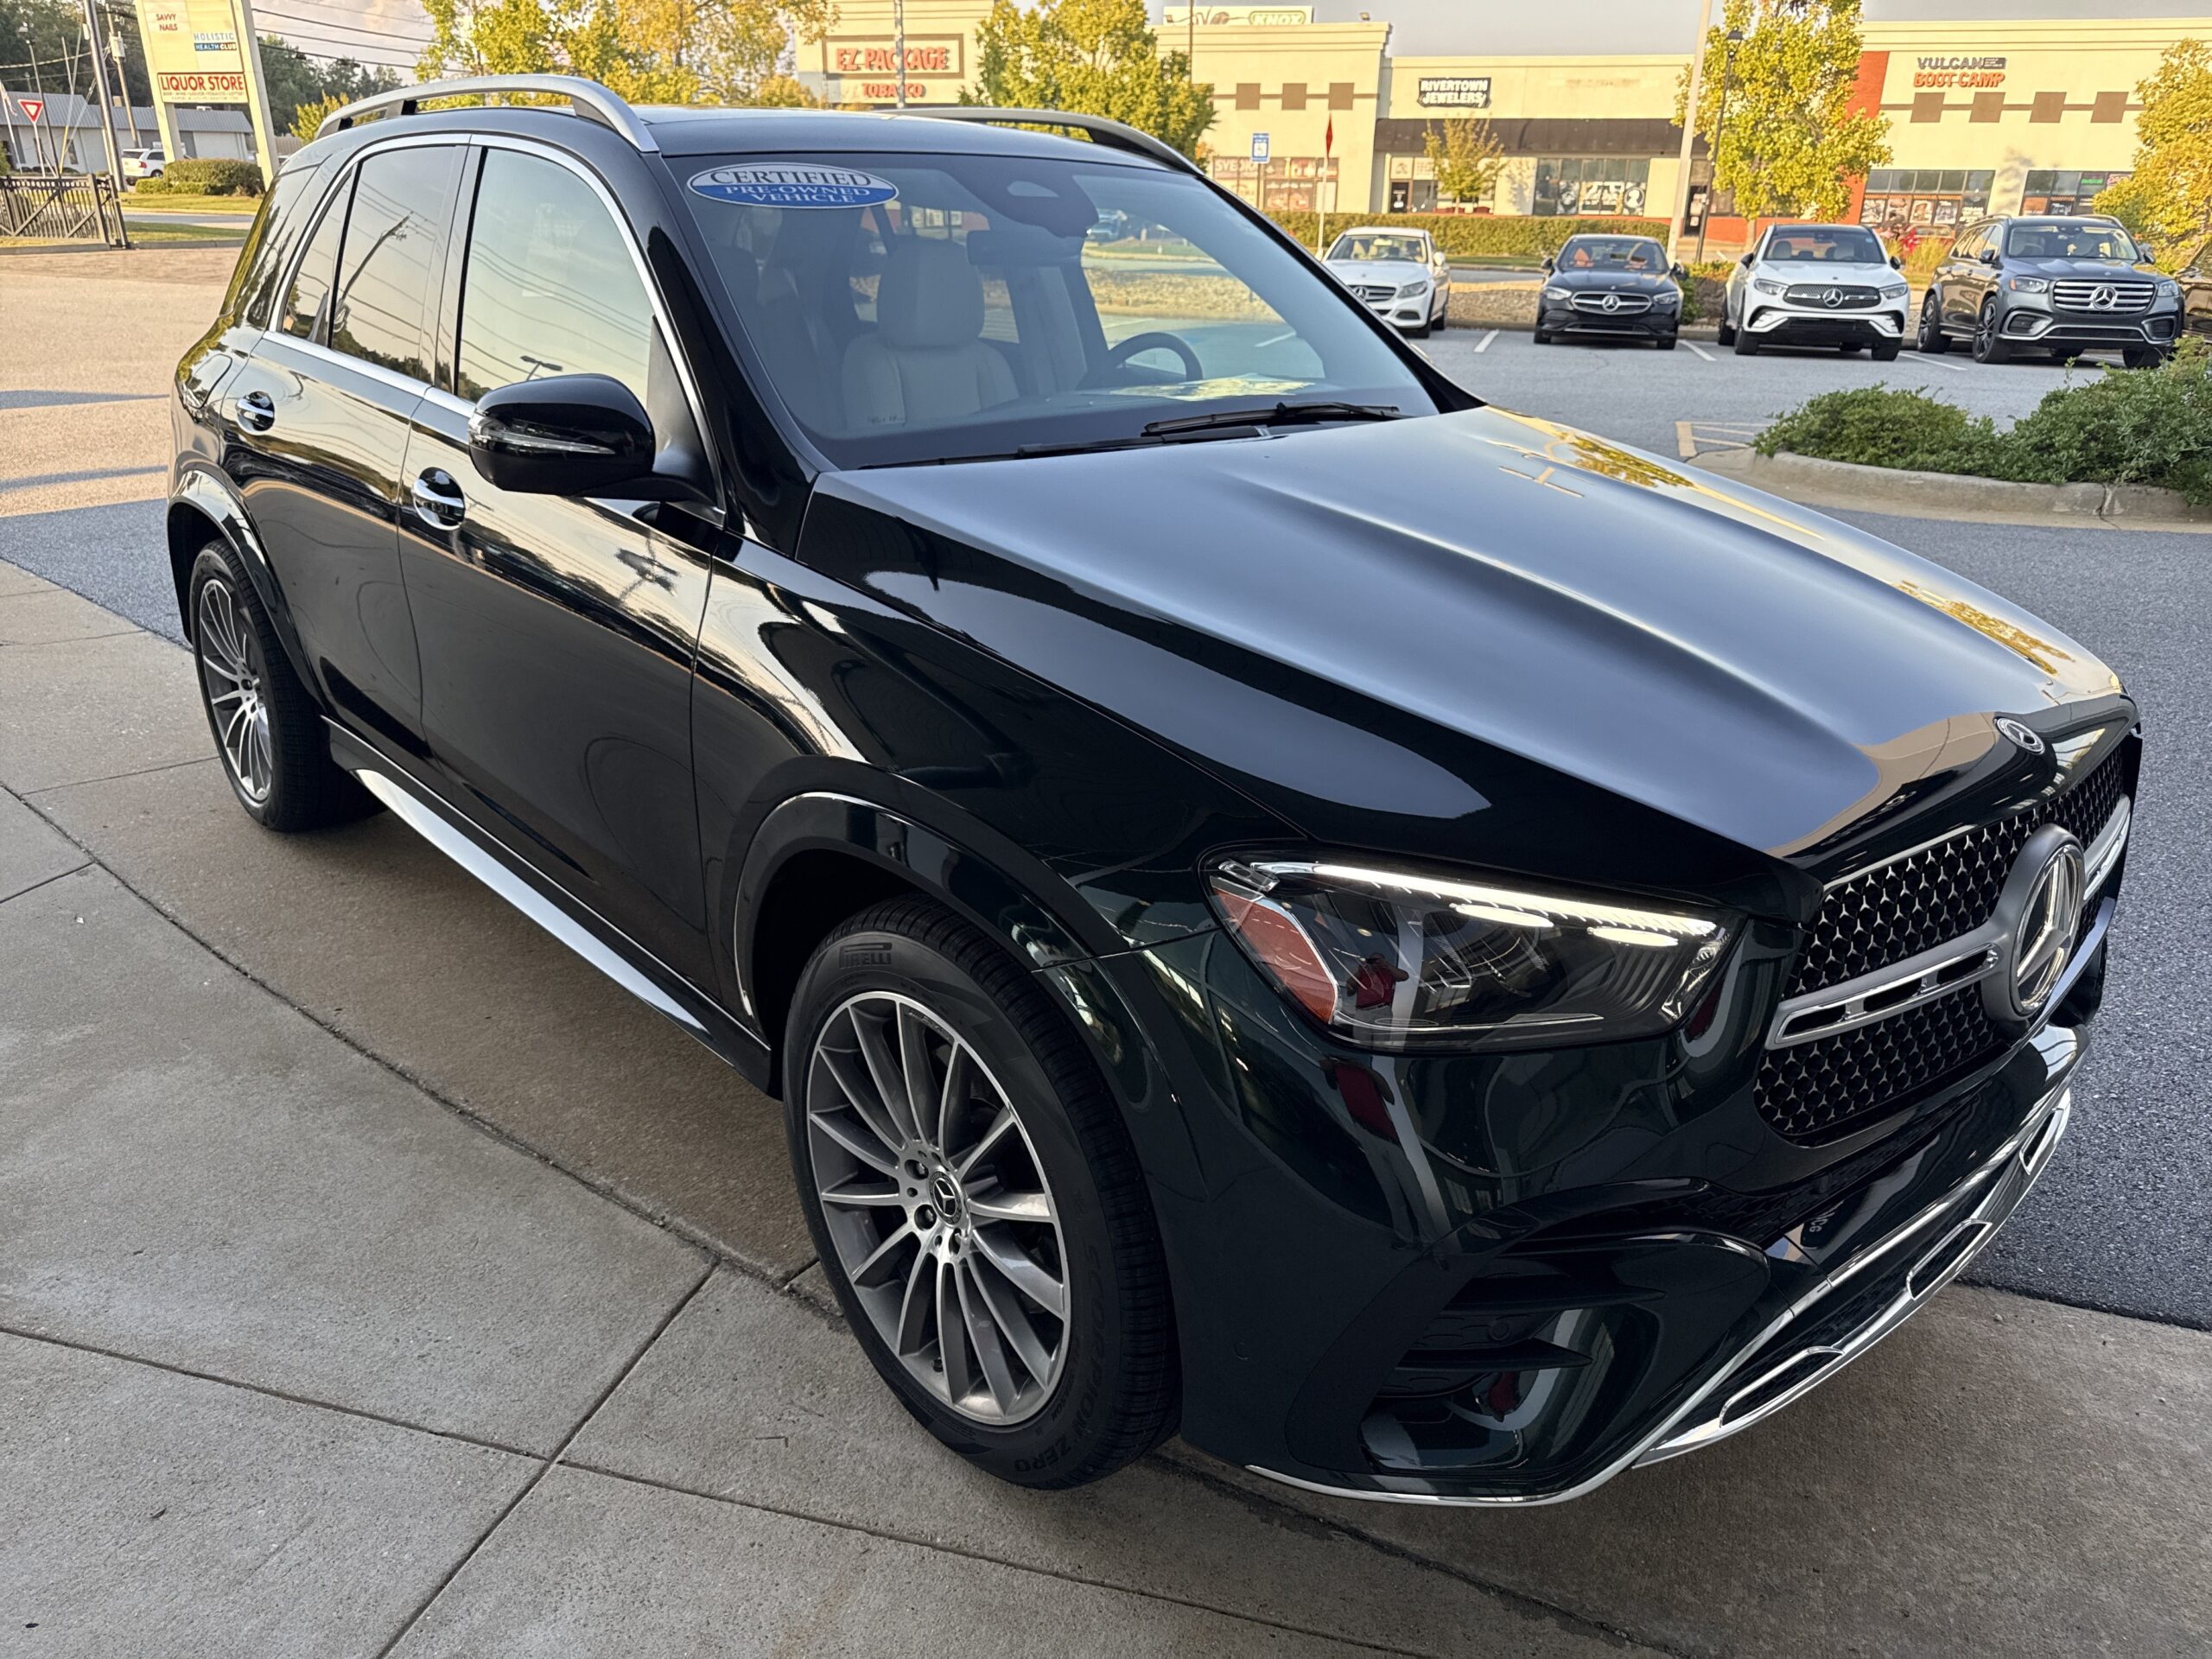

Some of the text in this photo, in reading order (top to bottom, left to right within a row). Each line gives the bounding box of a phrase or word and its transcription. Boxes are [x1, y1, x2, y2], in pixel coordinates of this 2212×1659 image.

[836, 48, 858, 71] EZ
[1917, 57, 1984, 69] VULCAN
[161, 76, 244, 91] LIQUOR STORE
[1420, 79, 1488, 92] RIVERTOWN
[1914, 72, 2005, 87] BOOT CAMP
[862, 83, 925, 98] TOBACO
[1422, 92, 1484, 105] JEWELERS
[710, 170, 872, 187] CERTIFIED
[726, 185, 871, 196] PRE-OWNED
[751, 193, 855, 204] VEHICLE
[839, 943, 892, 968] PIRELLI
[1014, 1435, 1071, 1472] ZERO
